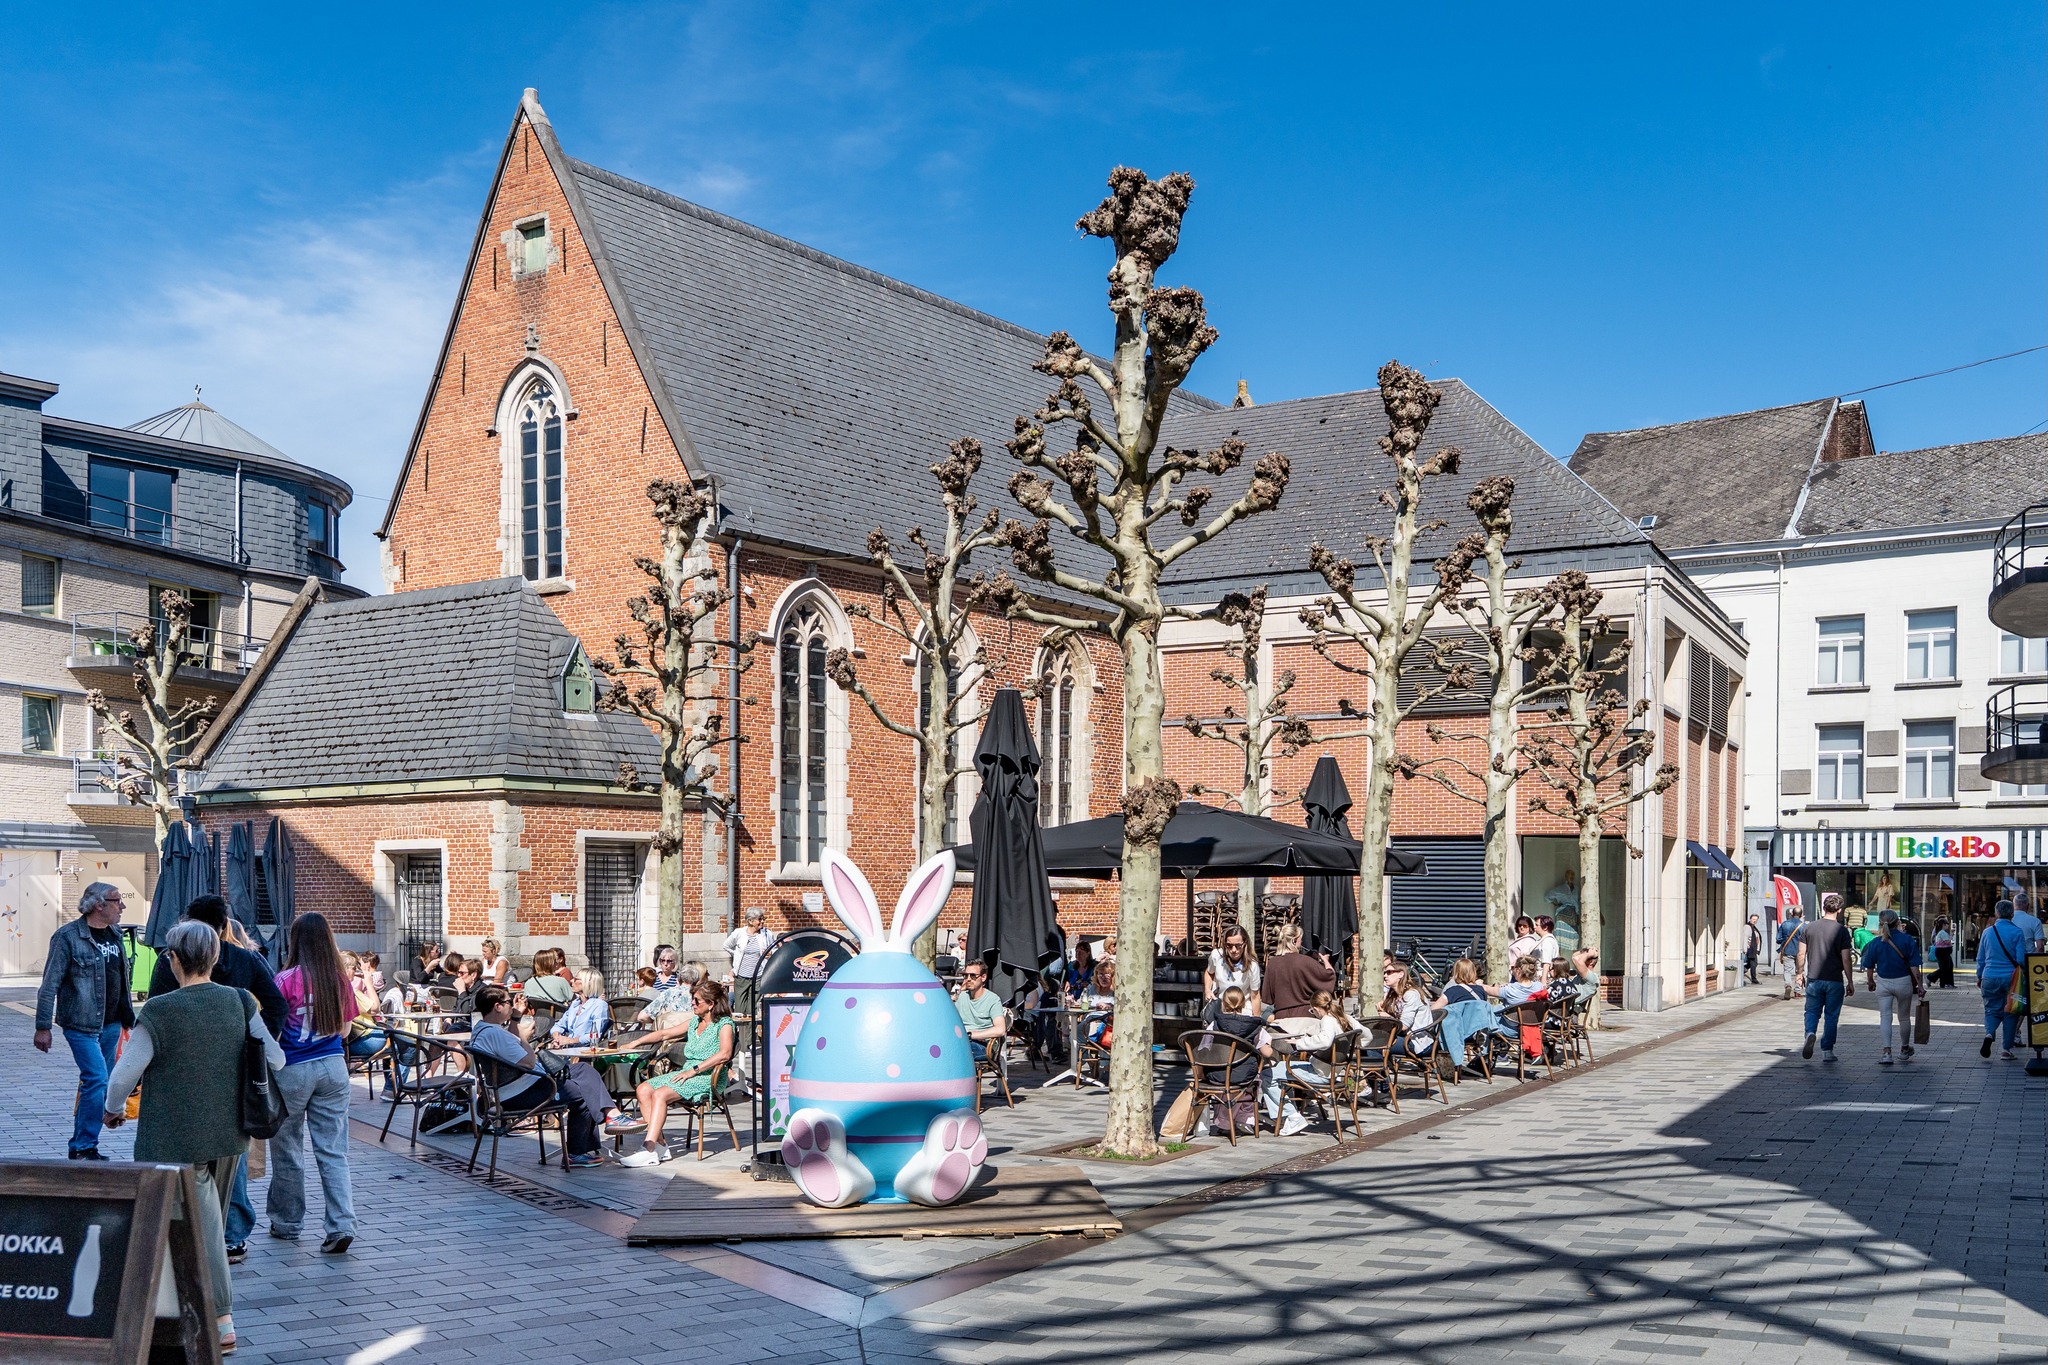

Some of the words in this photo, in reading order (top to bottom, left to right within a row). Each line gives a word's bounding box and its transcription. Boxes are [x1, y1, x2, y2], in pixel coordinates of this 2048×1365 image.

[1896, 836, 2001, 858] Bel&Bo
[2033, 1014, 2046, 1022] UP
[0, 1234, 64, 1254] OKKA
[15, 1285, 59, 1300] COLD
